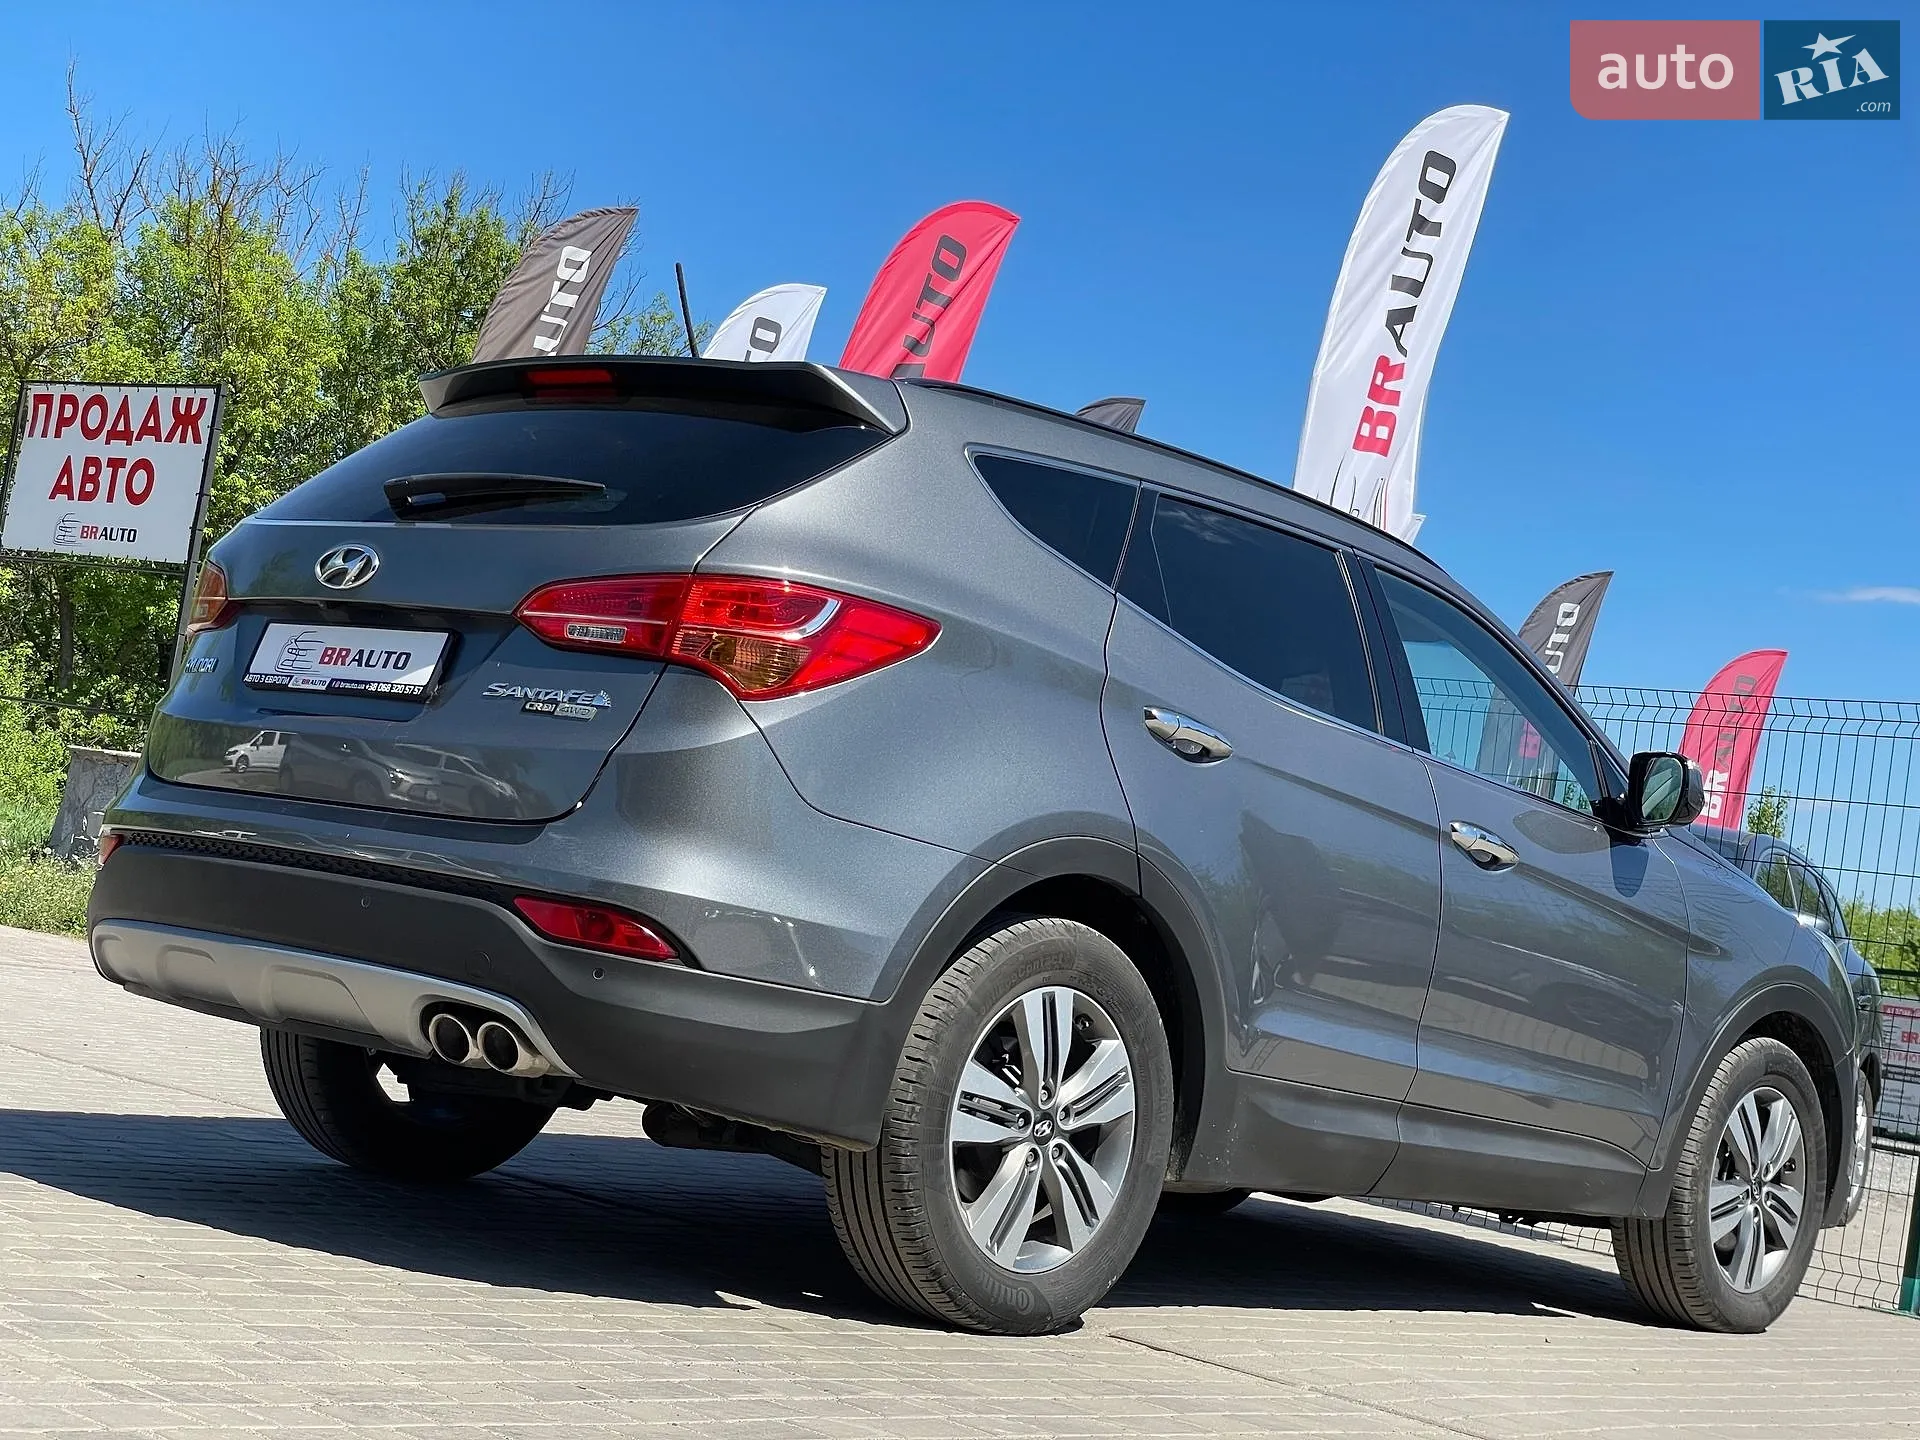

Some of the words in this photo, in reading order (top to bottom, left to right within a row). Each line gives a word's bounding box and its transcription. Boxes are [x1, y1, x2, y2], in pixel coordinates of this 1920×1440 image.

[533, 245, 593, 357] UTO
[1351, 149, 1457, 459] BRAUTO
[27, 393, 208, 447] ПРОДАЖ
[48, 454, 156, 507] АВТО
[79, 525, 138, 543] BRAUTO
[318, 645, 412, 672] BRAUTO
[301, 678, 327, 687] BRAUTO
[391, 684, 404, 694] 320
[404, 685, 414, 695] 57
[413, 686, 424, 696] 57
